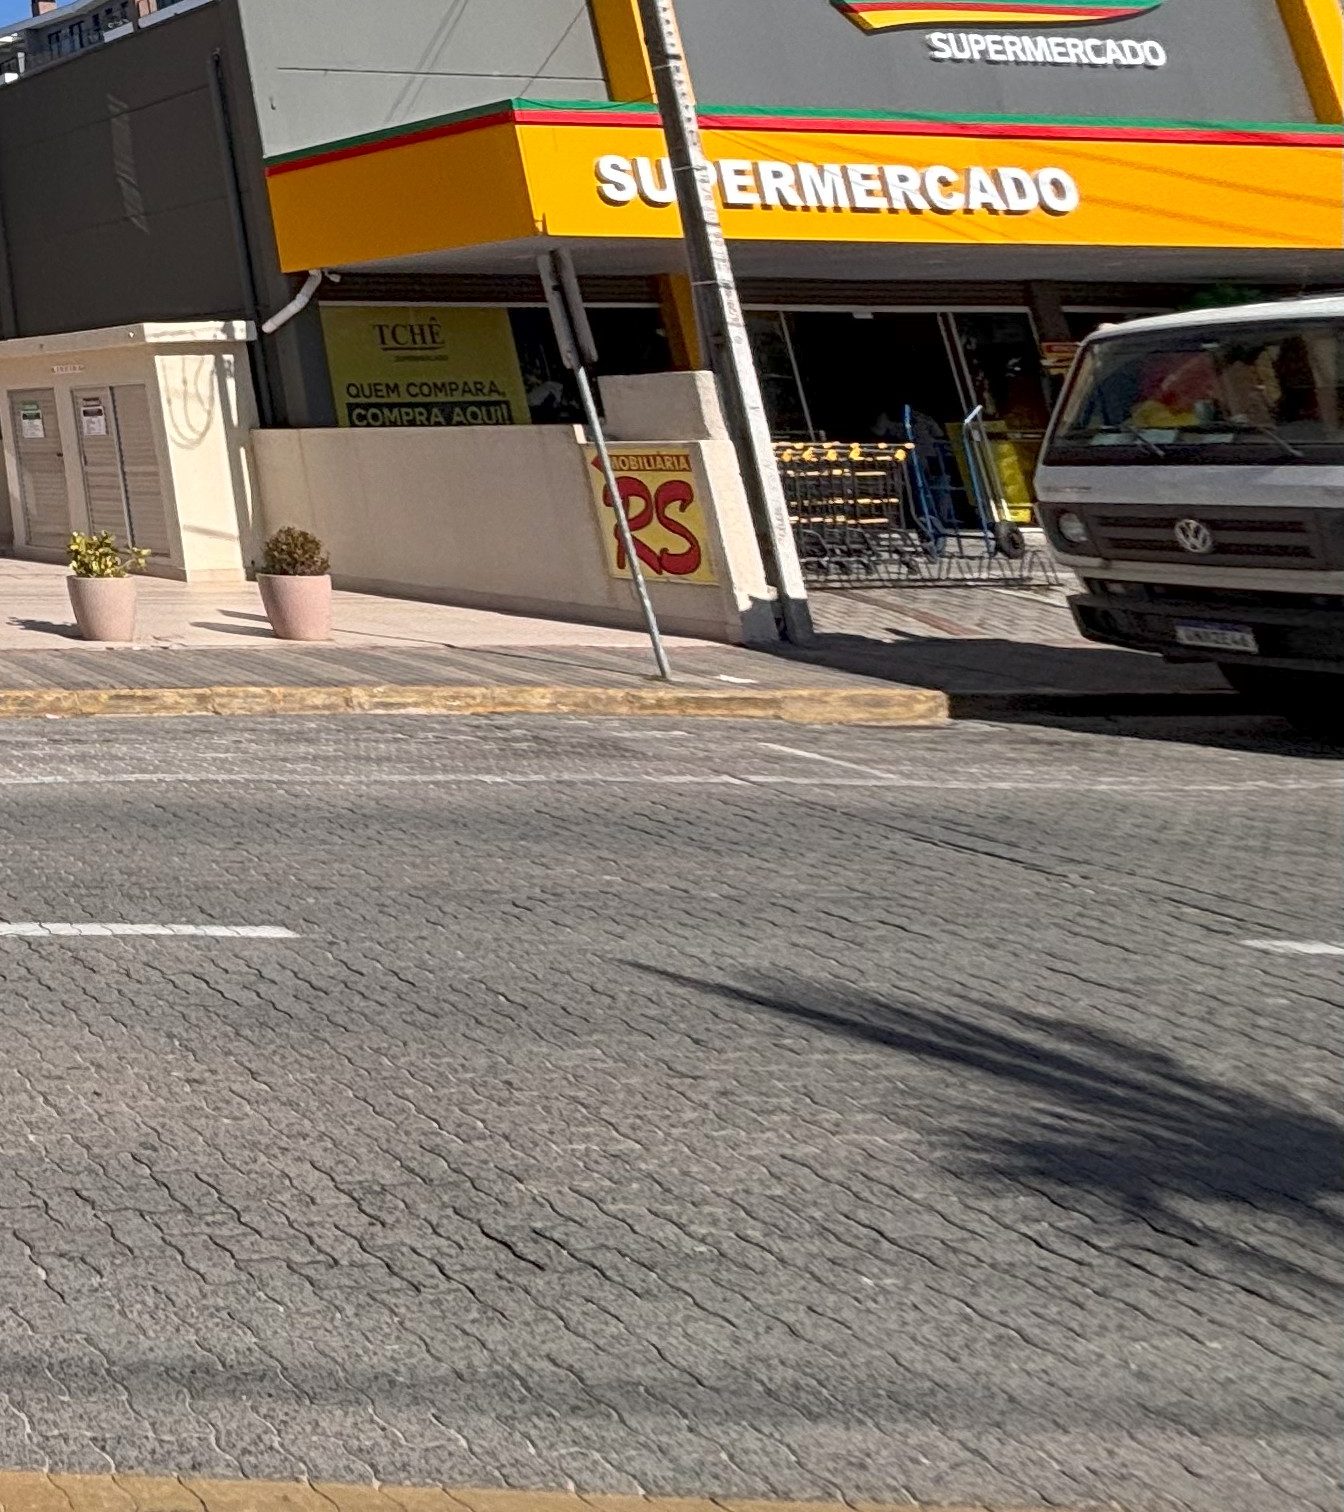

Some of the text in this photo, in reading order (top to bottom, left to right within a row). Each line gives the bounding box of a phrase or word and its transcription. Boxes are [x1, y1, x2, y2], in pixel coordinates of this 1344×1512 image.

[927, 31, 1168, 67] SUPERMERCADO
[372, 317, 446, 346] TCHÊ
[346, 380, 507, 399] QUEM COMPARA,
[352, 403, 511, 426] COMPRA AQUI!
[609, 451, 690, 470] MOBILIÁRIA
[603, 475, 702, 575] RS
